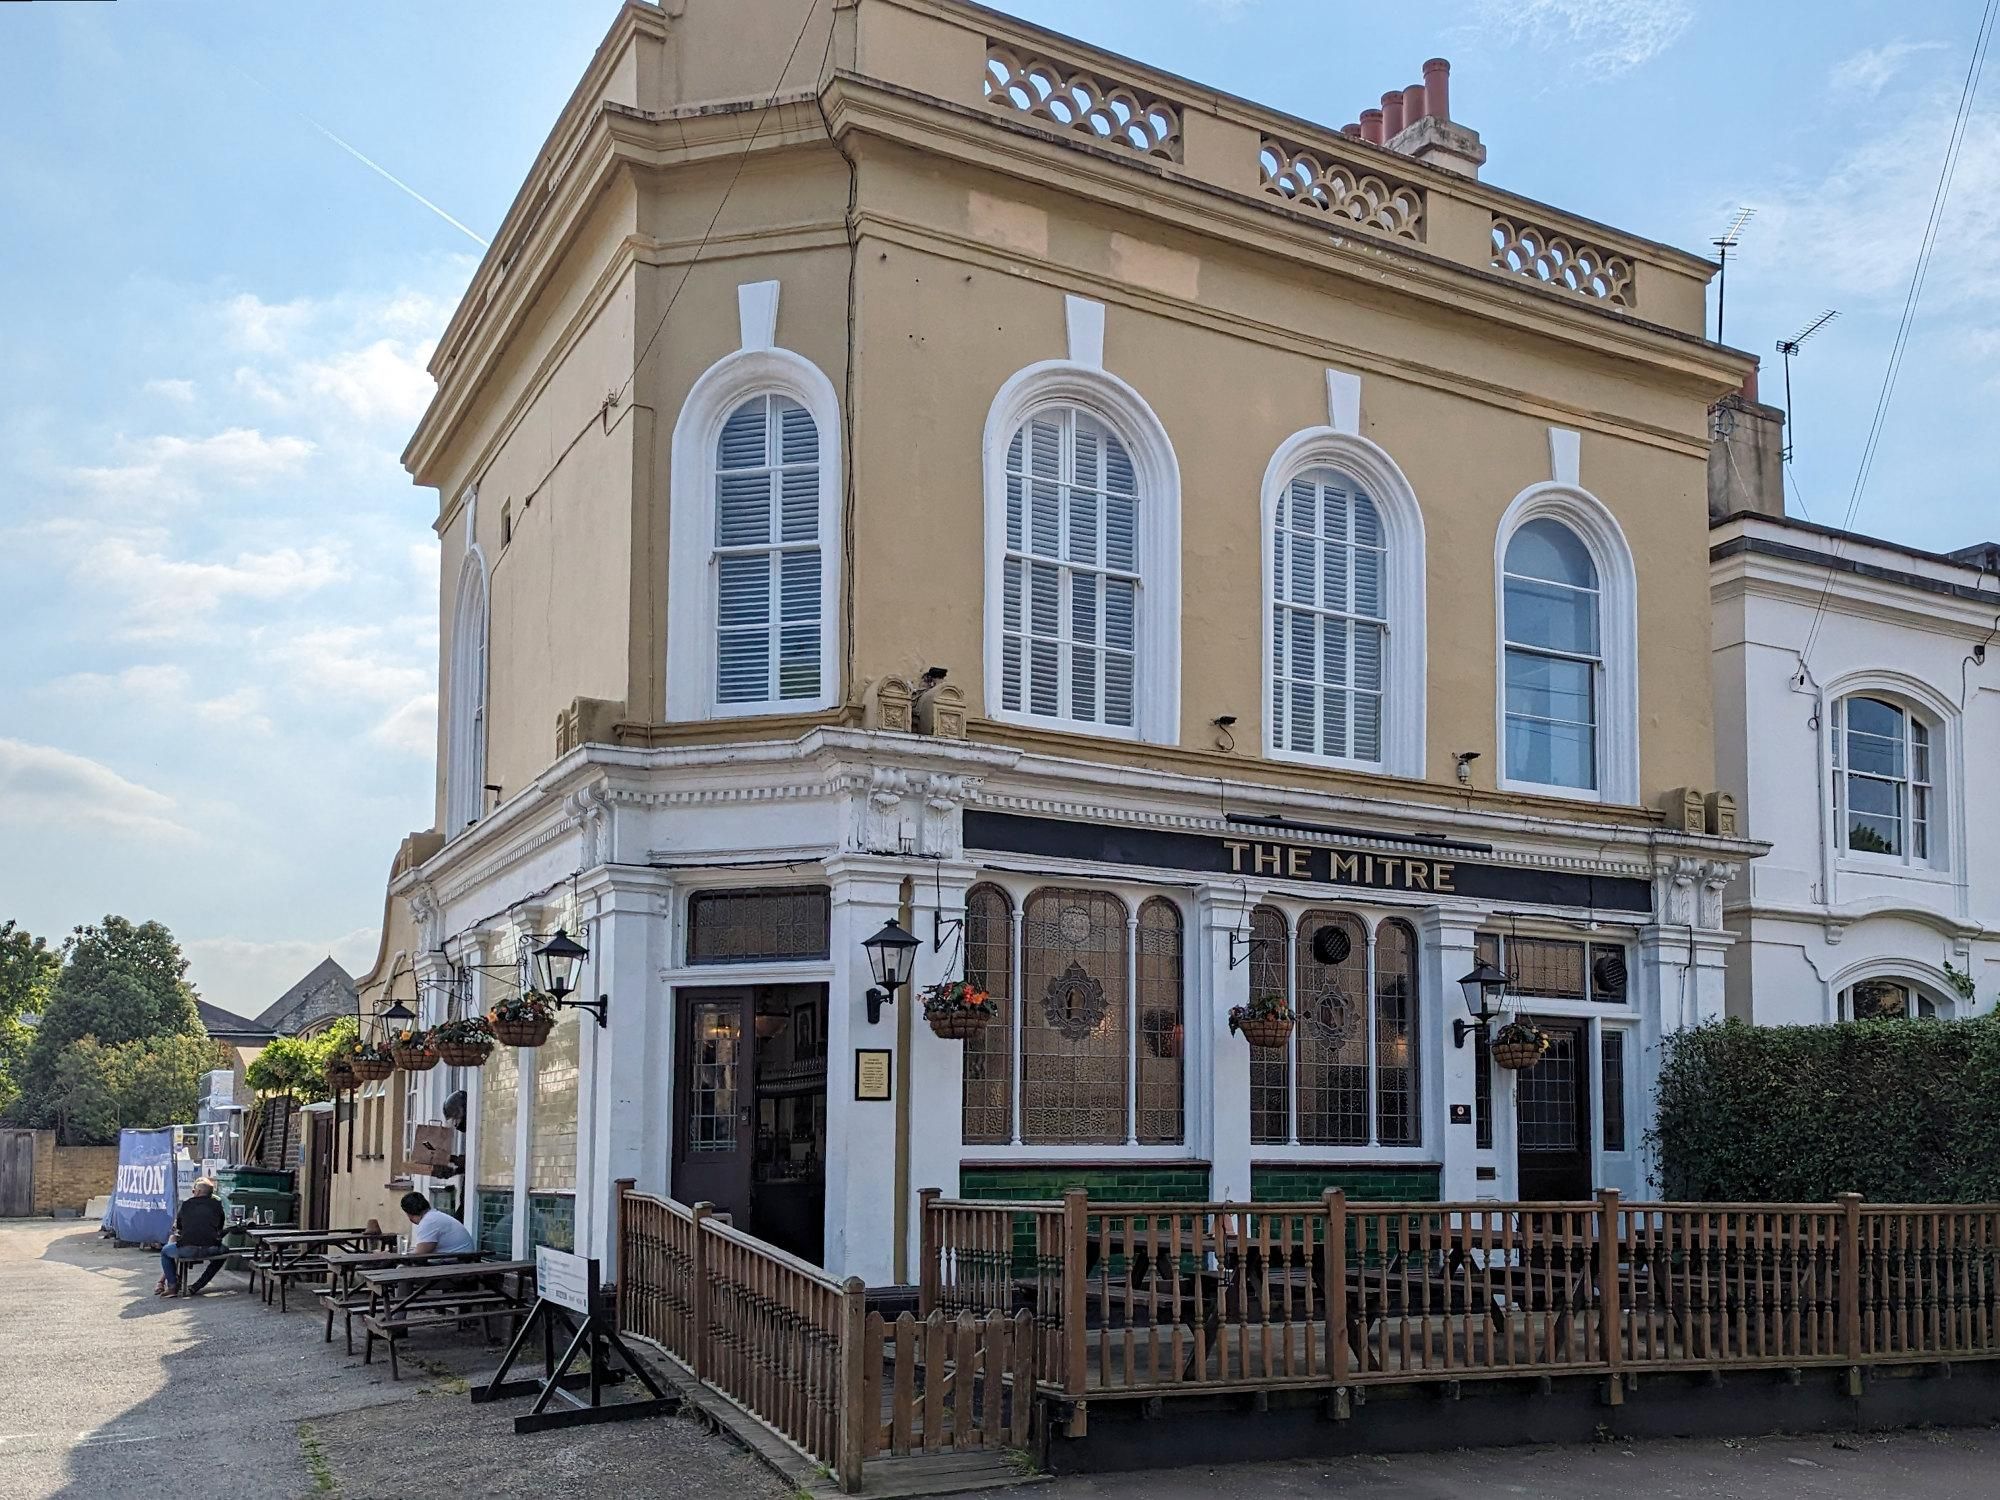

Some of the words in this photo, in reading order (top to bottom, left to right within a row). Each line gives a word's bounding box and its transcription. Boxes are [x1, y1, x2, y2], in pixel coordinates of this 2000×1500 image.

[1223, 840, 1312, 879] THE
[1330, 851, 1455, 891] MITRE
[117, 1165, 166, 1195] BUXTON
